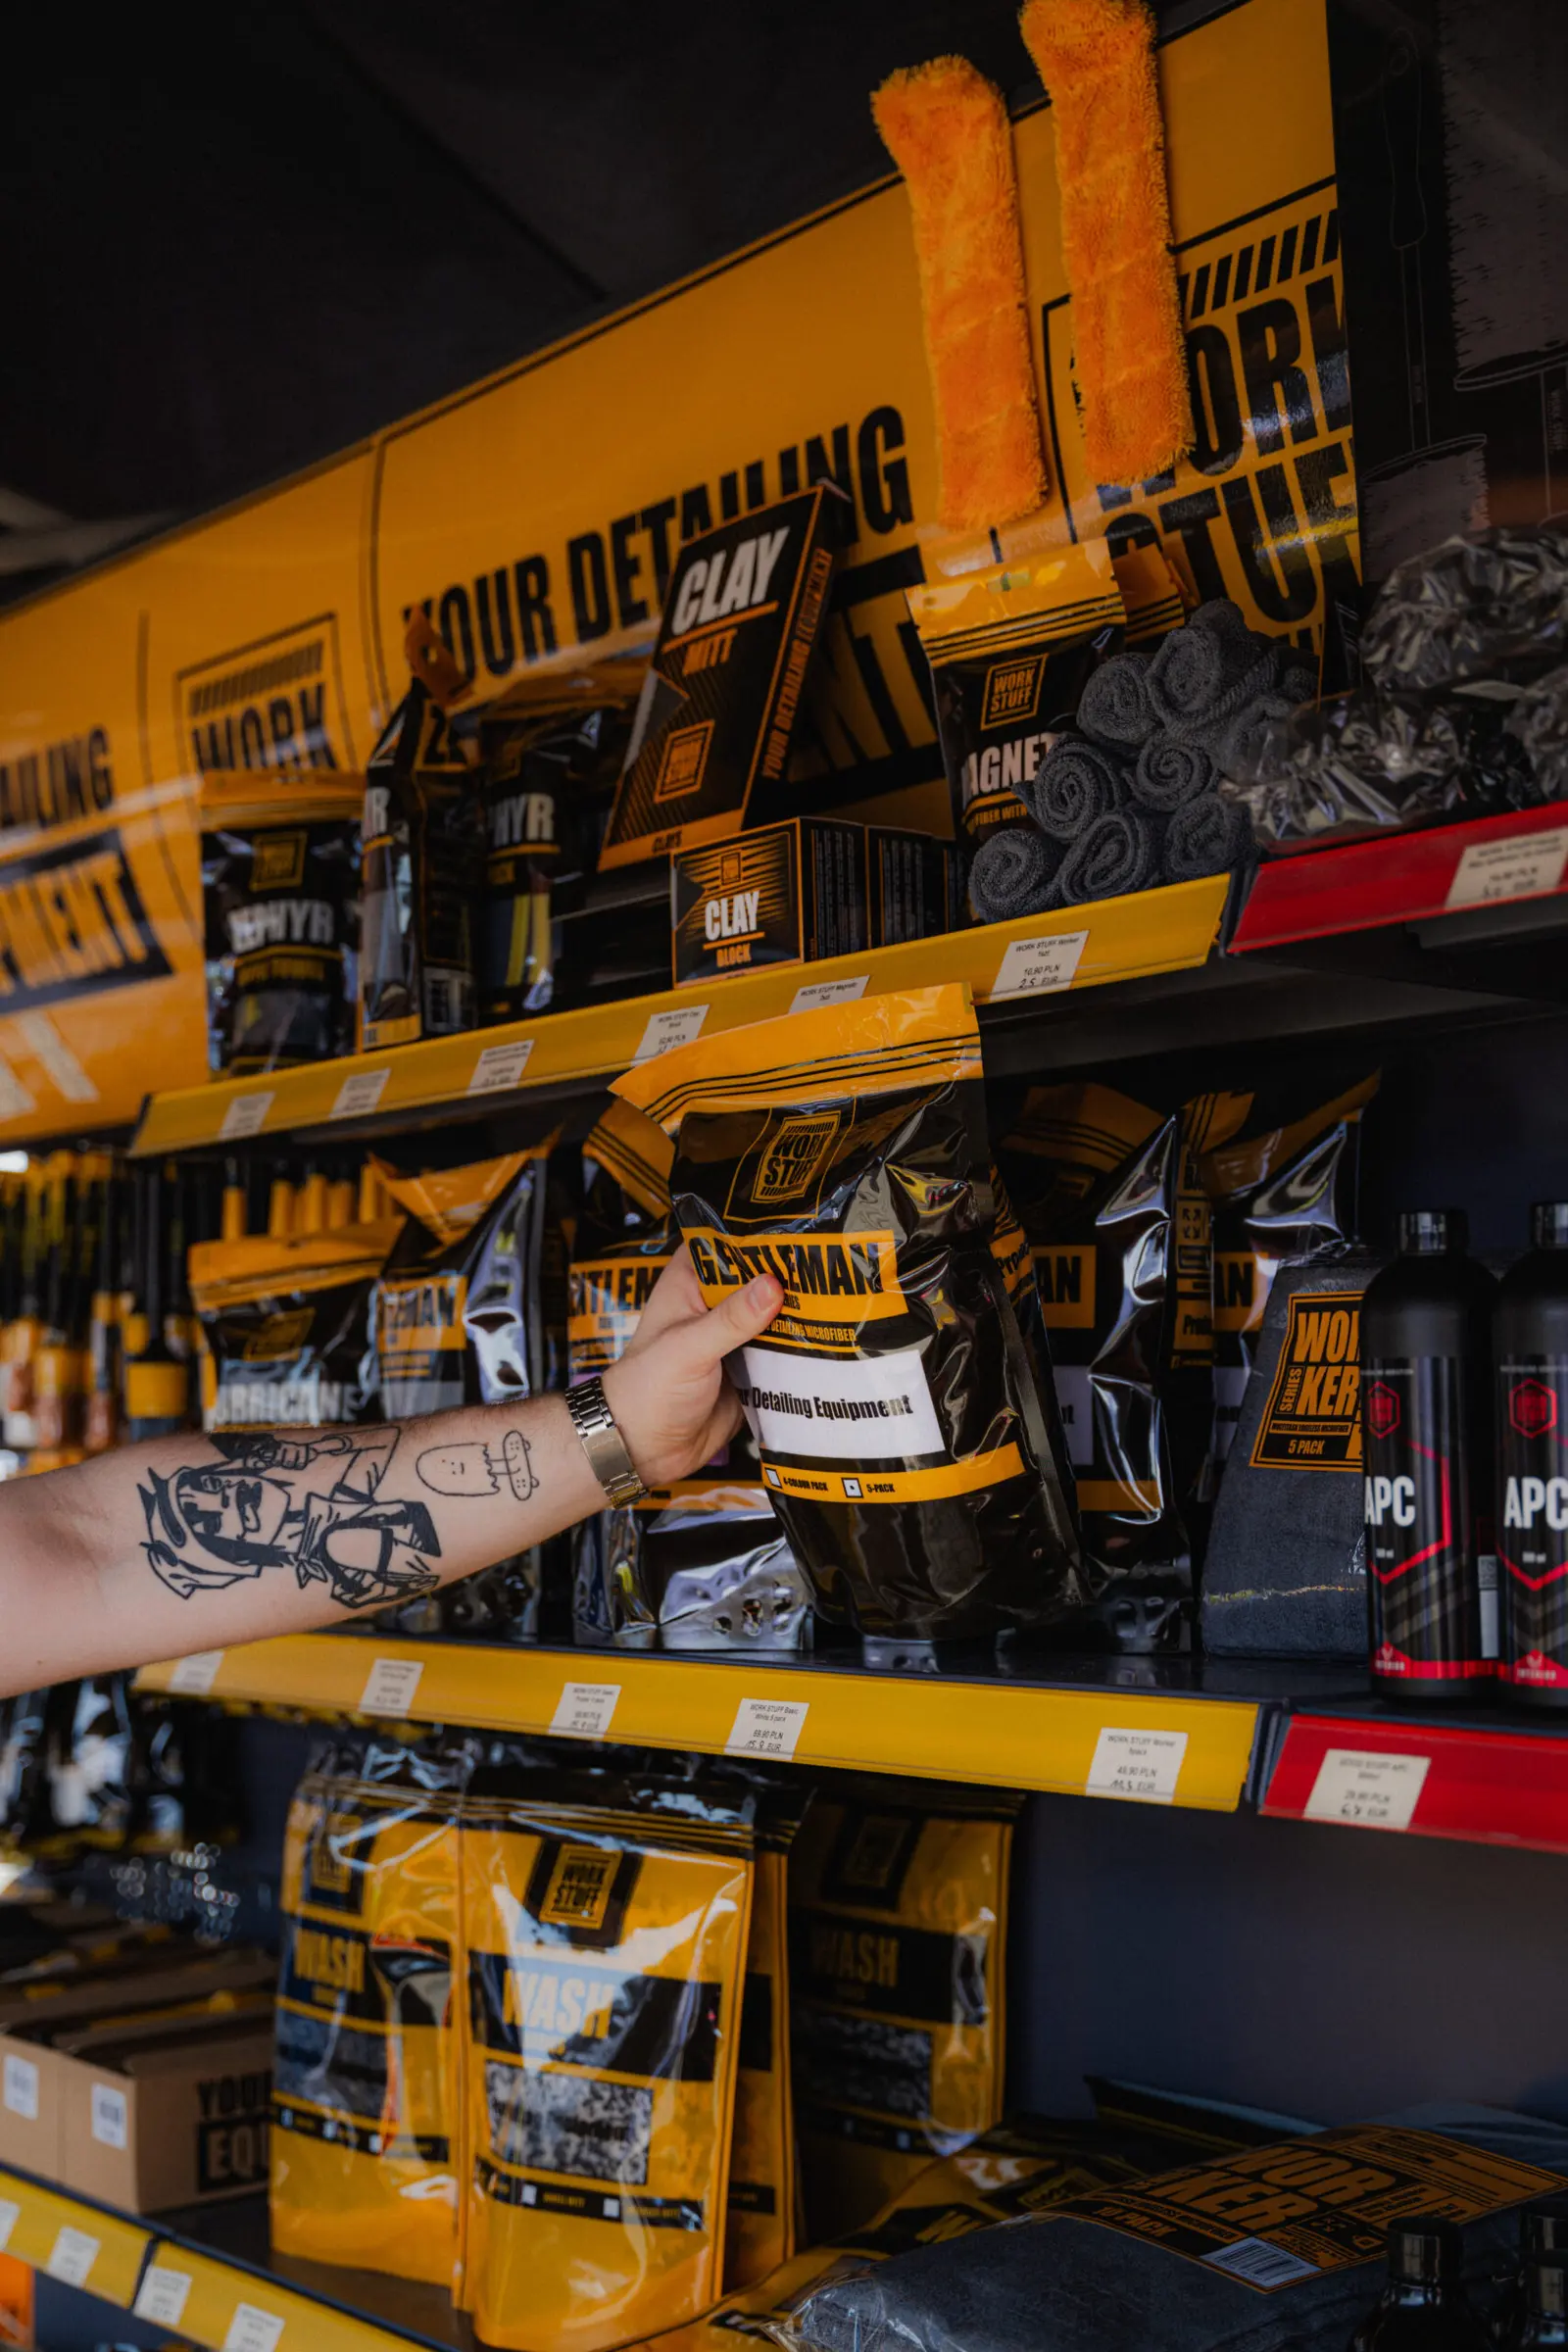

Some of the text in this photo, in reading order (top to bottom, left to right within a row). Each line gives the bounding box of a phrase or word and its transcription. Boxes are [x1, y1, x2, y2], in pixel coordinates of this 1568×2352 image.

[671, 526, 790, 636] CLAY
[773, 638, 812, 733] DETAILING
[990, 690, 1033, 713] STUFF
[994, 666, 1036, 694] WORK
[705, 890, 760, 942] CLAY
[716, 943, 753, 969] BLOCK
[689, 1236, 885, 1297] GENTLEMAN
[805, 1324, 858, 1343] MICROFIBER
[752, 1386, 812, 1419] Detailing
[812, 1396, 913, 1421] Equipment
[1279, 1367, 1303, 1412] SERIES
[1295, 1365, 1360, 1416] KER
[1288, 1440, 1326, 1455] 5 PACK
[811, 1480, 829, 1492] PACK
[866, 1482, 896, 1494] 5-PACK
[1364, 1474, 1417, 1528] APC
[1503, 1475, 1568, 1531] APC
[769, 1730, 784, 1740] PLN
[294, 1928, 366, 1992] WASH
[502, 1968, 616, 2039] WASH
